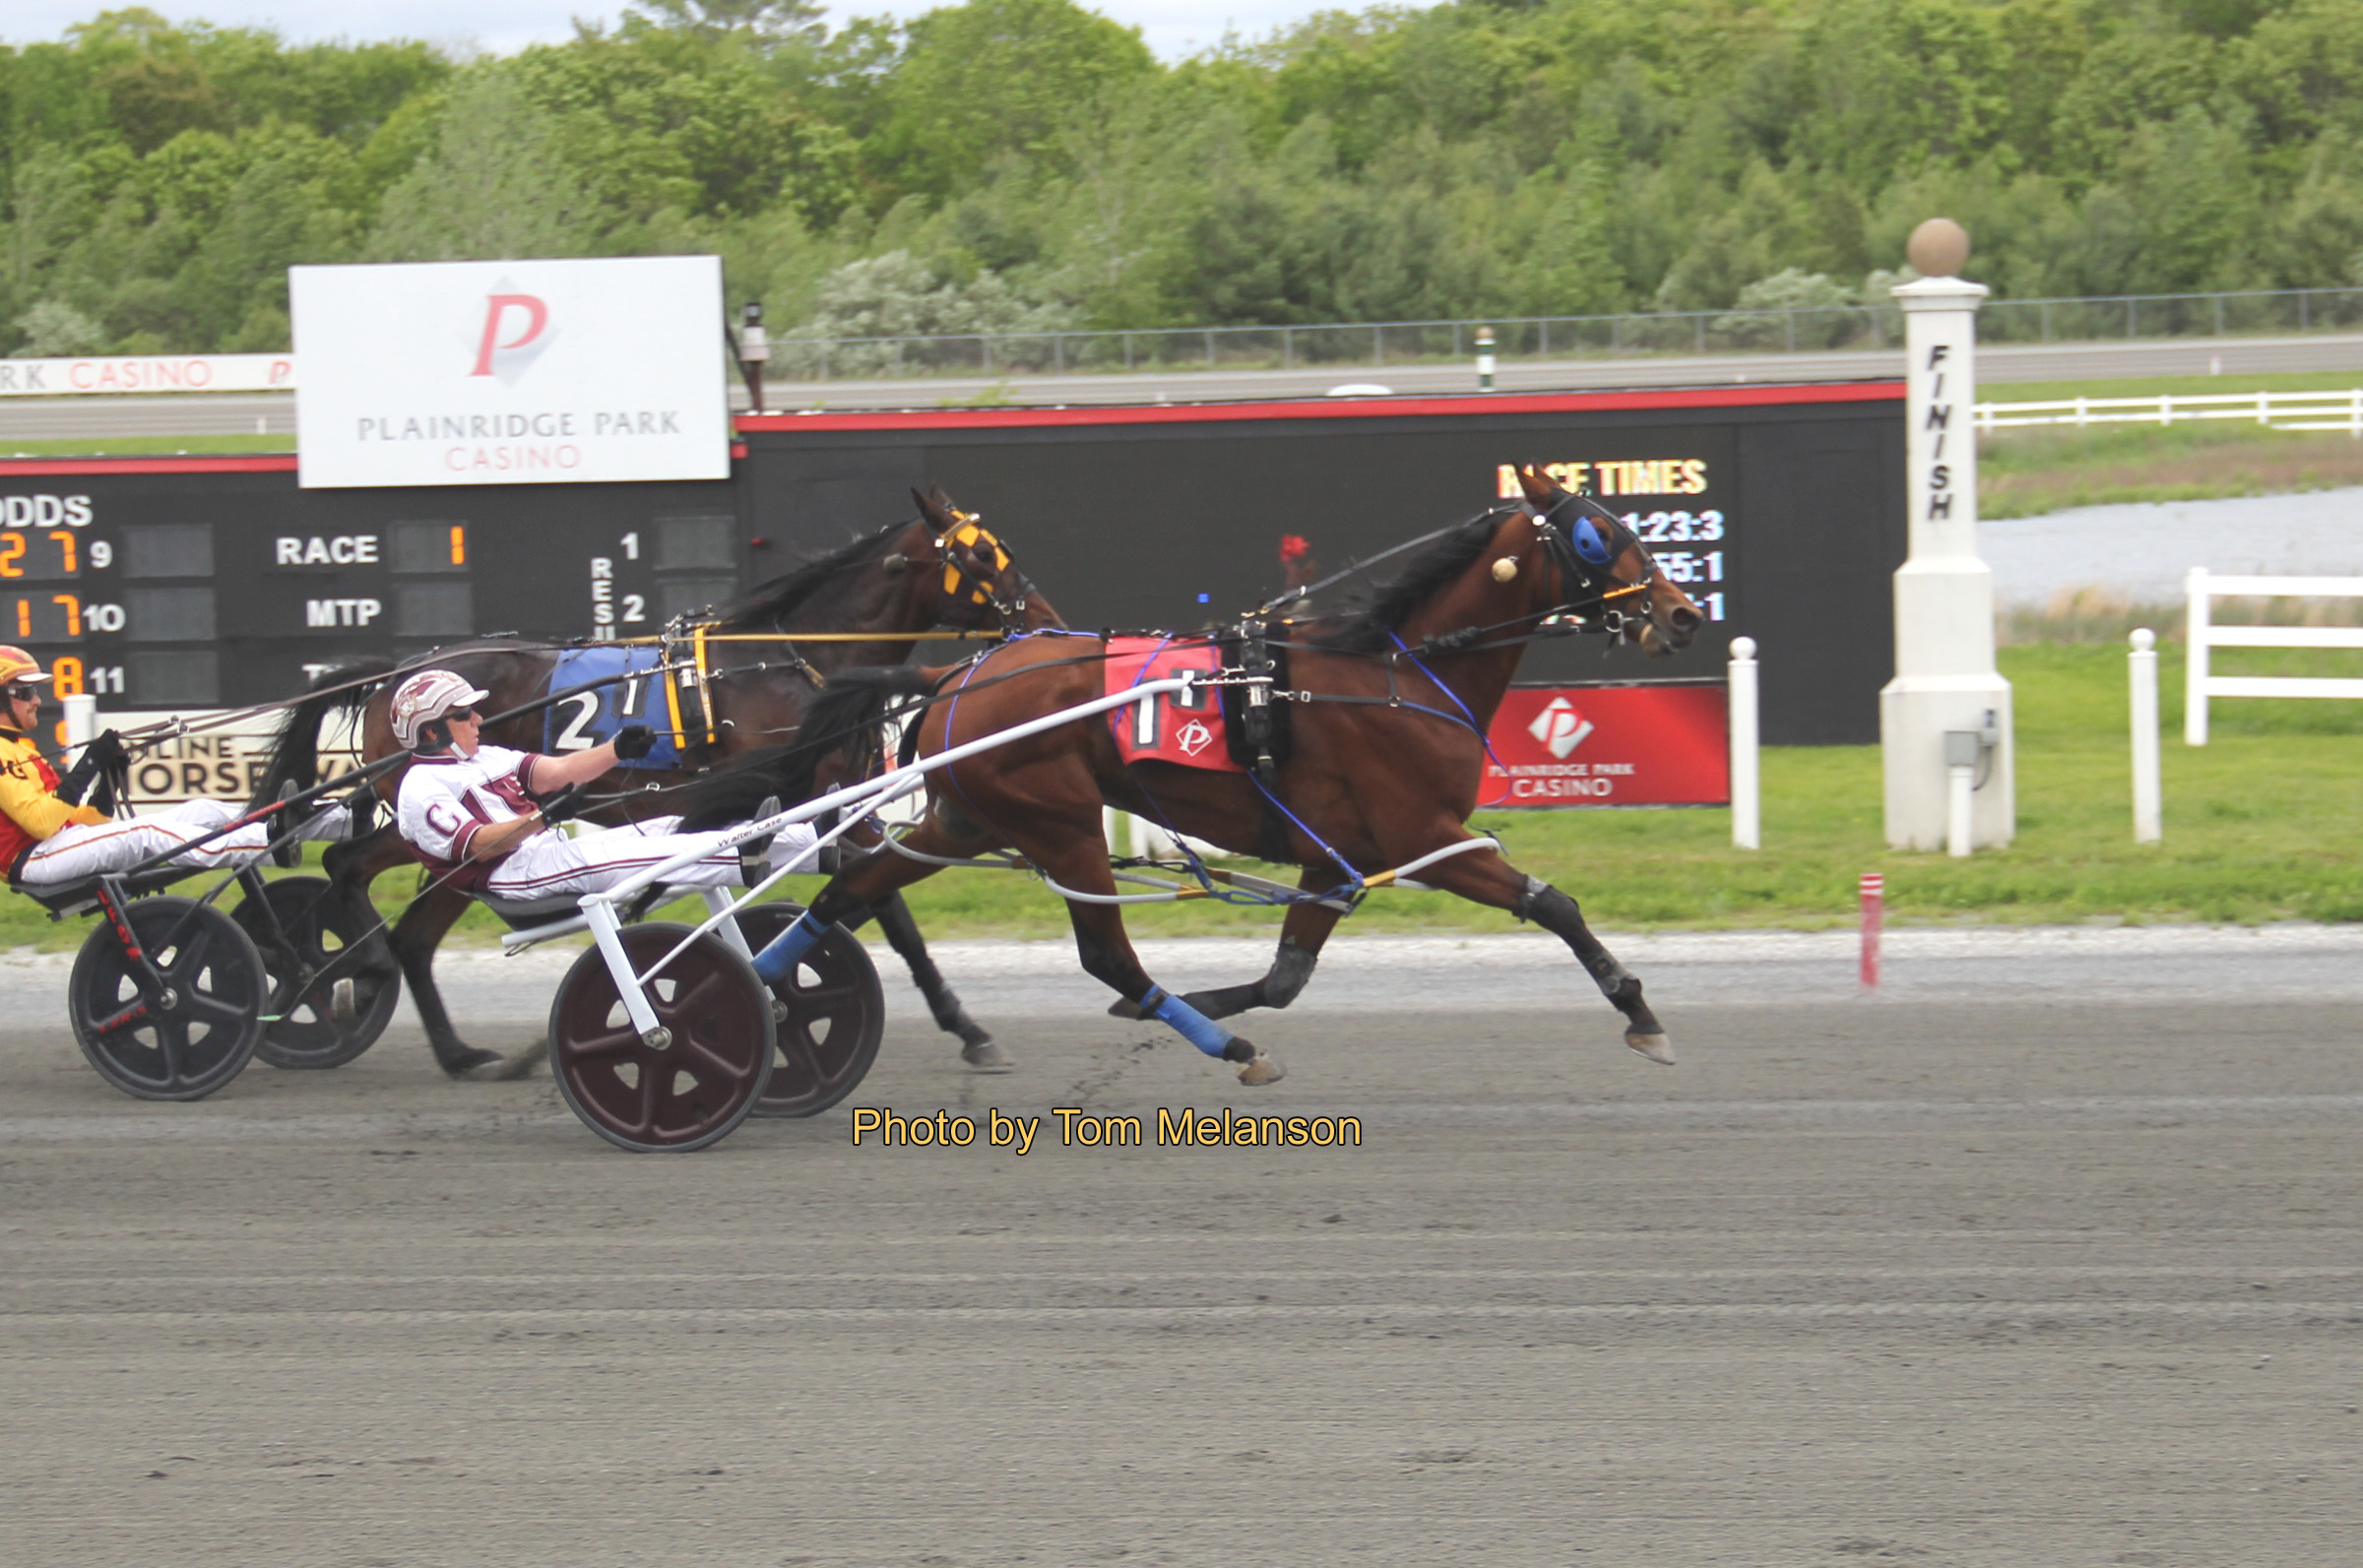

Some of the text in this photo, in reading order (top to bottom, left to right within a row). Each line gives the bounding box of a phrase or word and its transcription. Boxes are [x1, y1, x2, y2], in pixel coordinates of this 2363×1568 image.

[68, 359, 213, 390] CASINO
[357, 409, 681, 441] PLAINRIDGE PARK
[1926, 345, 1952, 521] FINISH
[444, 444, 583, 471] CASINO
[1497, 459, 1708, 499] RCE TIMES
[0, 494, 94, 528] DDS
[0, 531, 77, 577] 27
[90, 540, 112, 568] 9
[276, 534, 379, 565] RACE
[450, 526, 465, 565] 1
[620, 532, 640, 560] 1
[17, 594, 81, 638] 17
[83, 603, 126, 631] 10
[306, 598, 382, 627] MTP
[622, 594, 646, 622] 2
[90, 666, 125, 694] 11
[554, 691, 599, 749] 2
[145, 737, 233, 759] LINE
[1488, 763, 1635, 778] PLAINRIDGE PARK
[1512, 777, 1614, 798] CASINO
[717, 817, 783, 847] Walter Case
